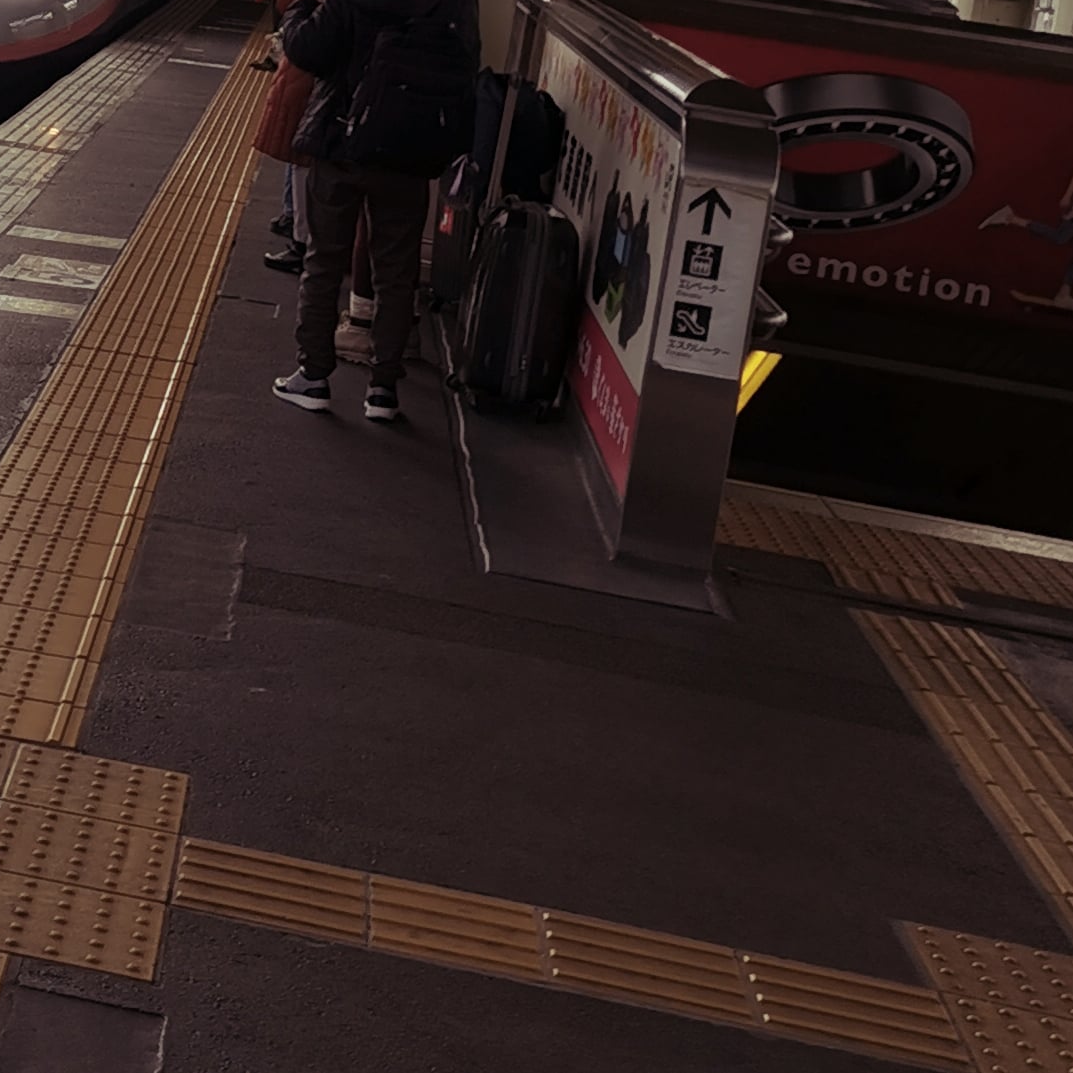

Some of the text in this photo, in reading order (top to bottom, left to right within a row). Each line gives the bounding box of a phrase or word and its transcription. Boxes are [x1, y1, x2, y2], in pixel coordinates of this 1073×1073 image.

[678, 278, 726, 295] エレベーター
[786, 252, 992, 307] emotion
[666, 339, 731, 356] エスカレーター
